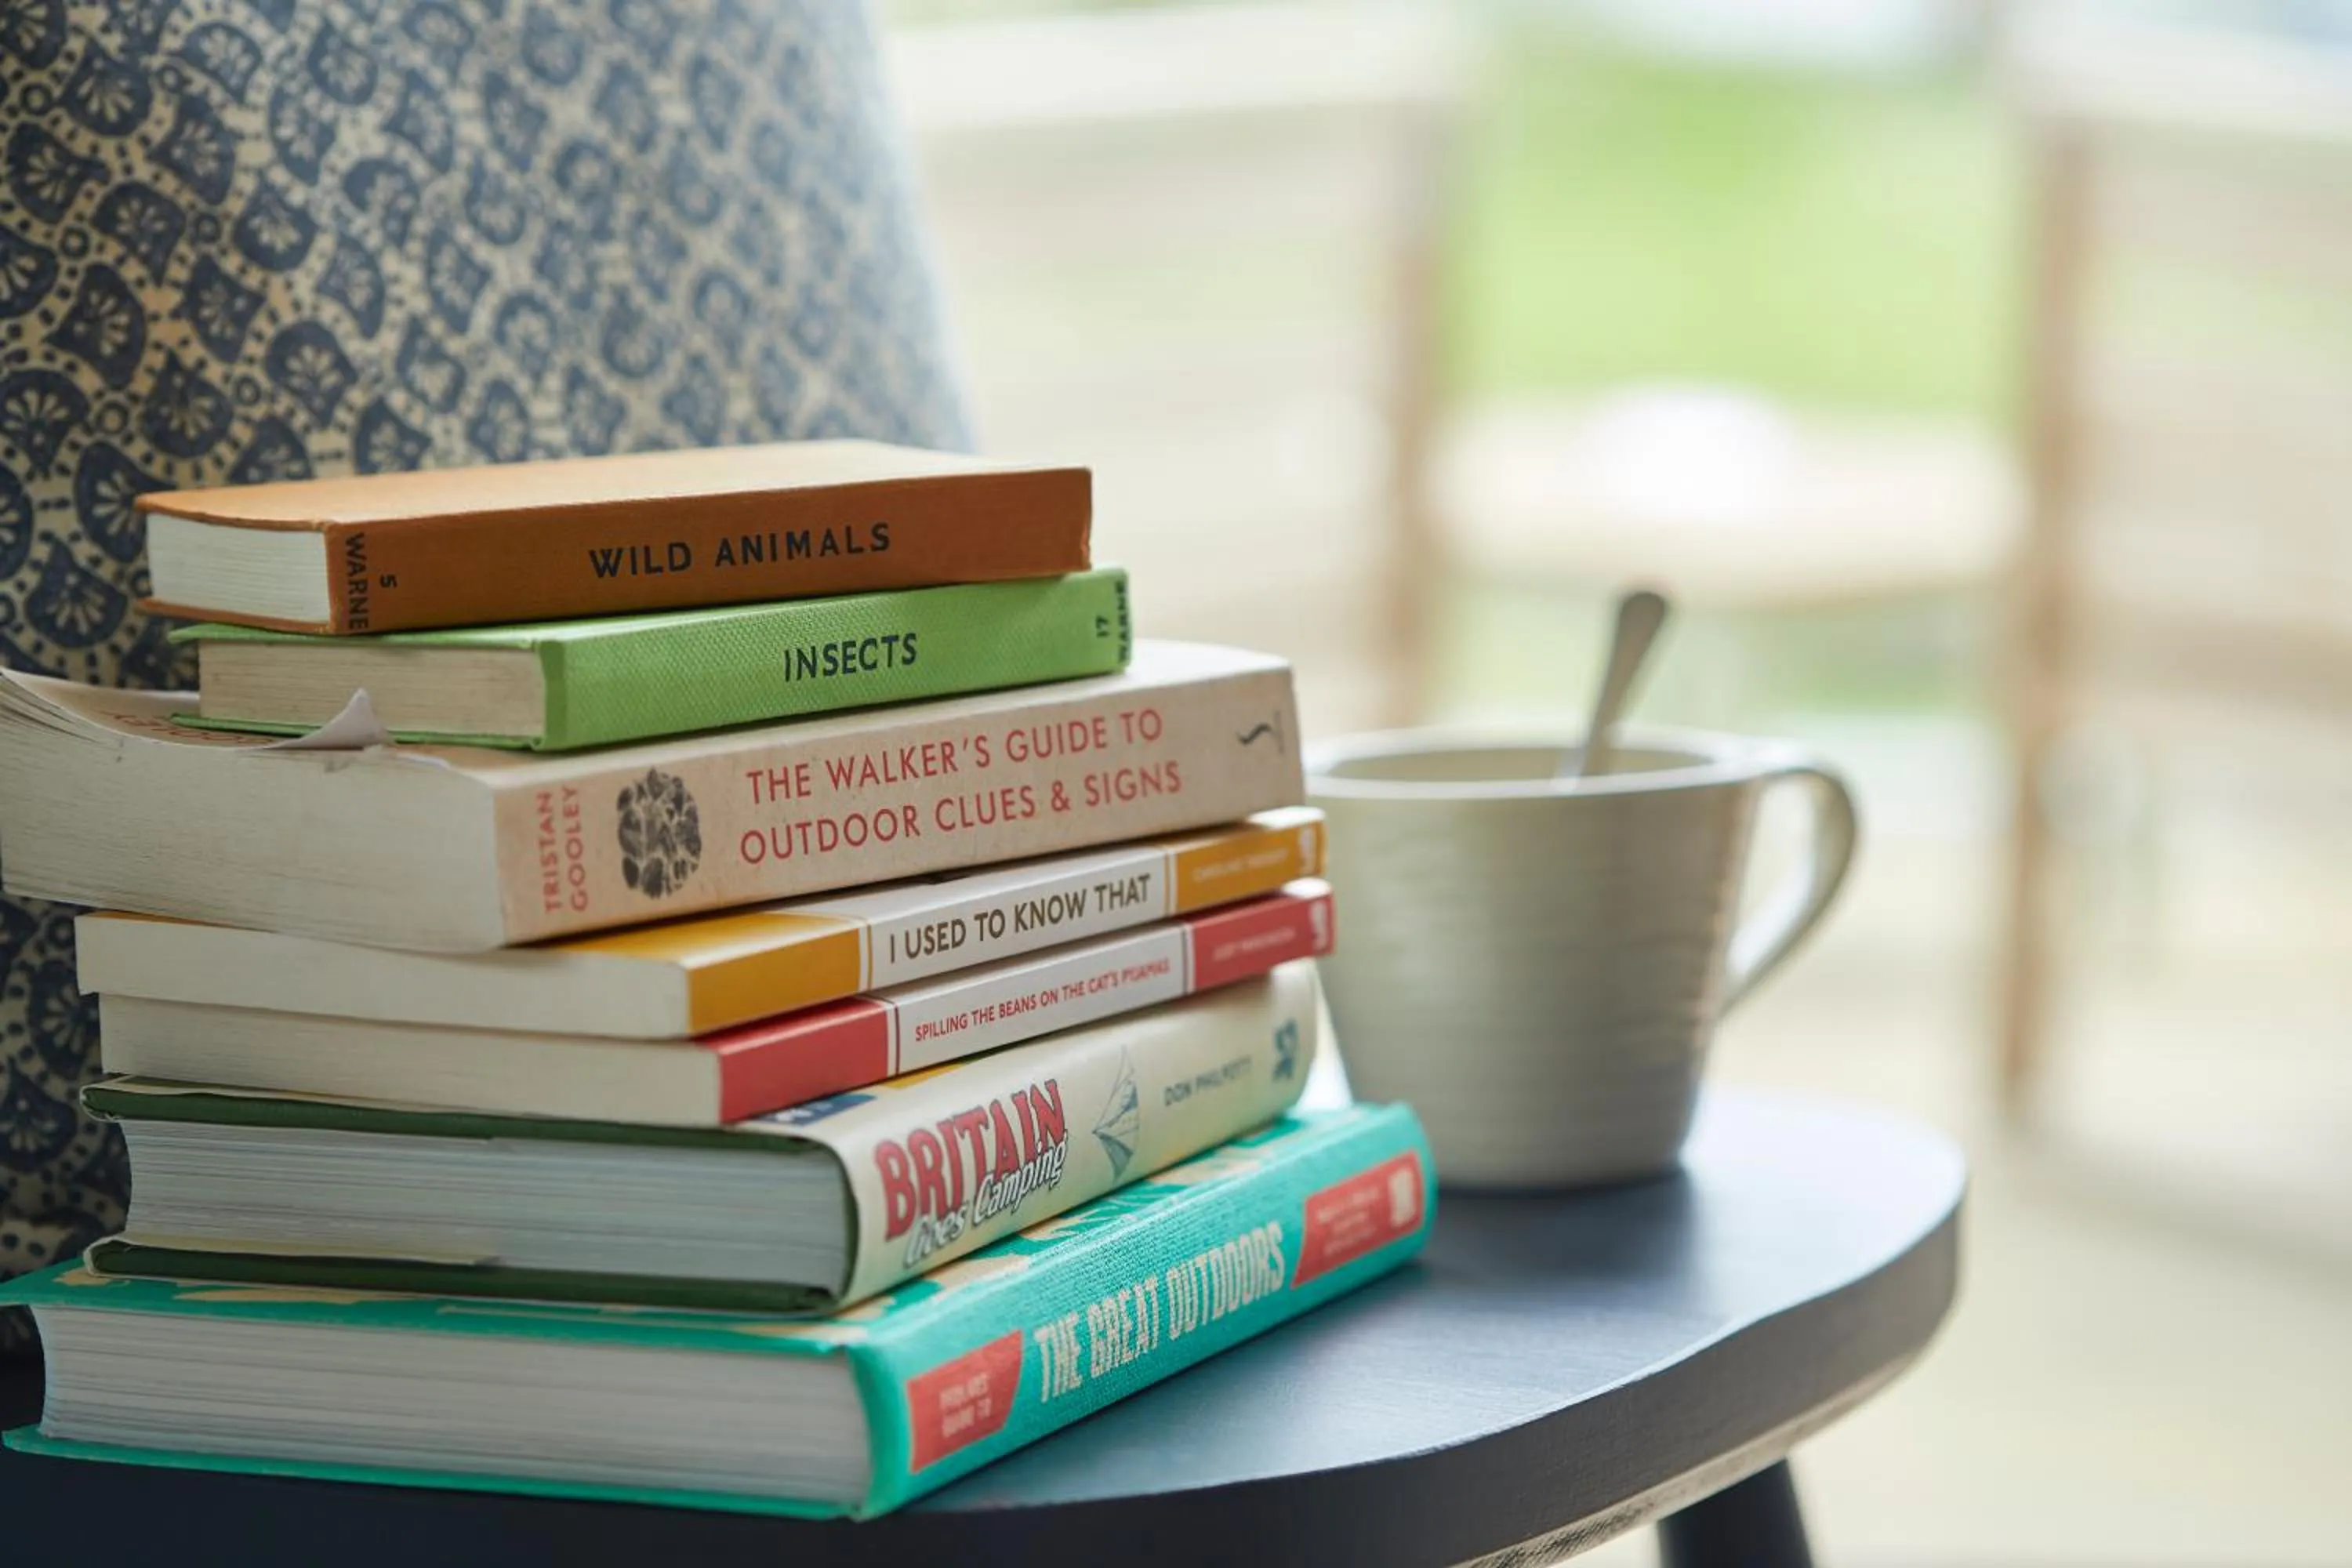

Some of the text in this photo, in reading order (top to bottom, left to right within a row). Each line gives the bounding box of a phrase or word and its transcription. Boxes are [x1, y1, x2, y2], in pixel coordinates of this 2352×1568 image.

[346, 532, 368, 630] WARNE
[379, 574, 397, 589] 5
[589, 523, 890, 579] WILD ANIMALS
[784, 633, 917, 682] INSECTS
[746, 709, 1163, 804] THE WALKER'S GUIDE TO
[535, 792, 561, 914] TRISTAN
[560, 786, 589, 912] GOOLEY
[741, 760, 1182, 864] OUTDOOR CLUES & SIGNS
[890, 873, 1151, 964] I USED TO KNOW THAT
[915, 1014, 968, 1042] SPILLING
[971, 1006, 995, 1025] THE
[998, 996, 1038, 1018] BEANS
[1040, 988, 1058, 1007] ON
[1062, 981, 1086, 1000] THE
[1088, 971, 1119, 993] CAT'S
[873, 1078, 1068, 1243] BRITAIN
[904, 1134, 1068, 1268] Goes Camping
[1033, 1310, 1082, 1403] THE
[1087, 1273, 1159, 1378] GREAT
[1167, 1220, 1285, 1341] OUTDOORS
